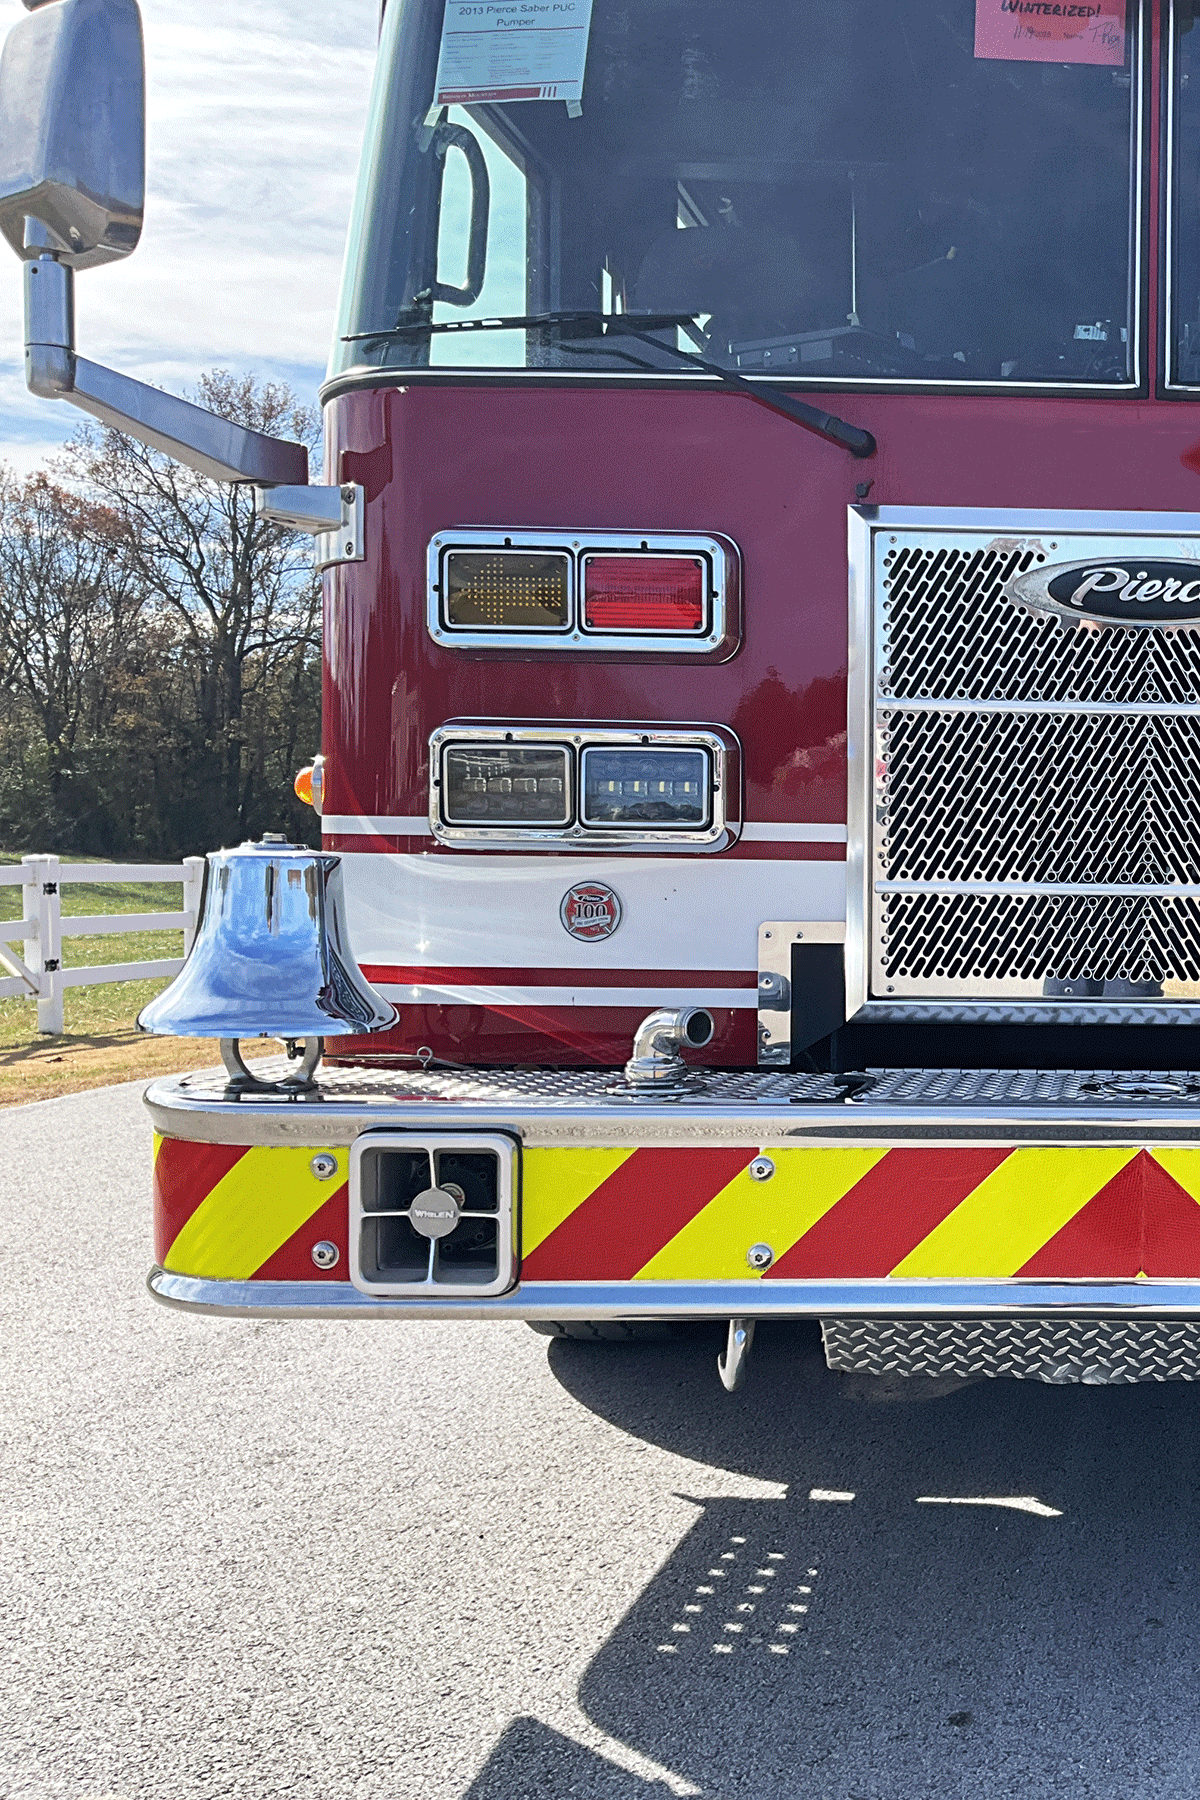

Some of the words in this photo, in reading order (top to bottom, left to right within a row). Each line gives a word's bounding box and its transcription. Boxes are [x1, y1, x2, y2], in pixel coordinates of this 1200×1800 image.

[459, 7, 484, 16] 2013
[486, 5, 518, 15] Pierce
[520, 4, 550, 13] Saber
[552, 3, 576, 12] PUC
[496, 18, 536, 27] Pumper
[574, 903, 608, 918] 100
[414, 1209, 455, 1219] WHELEN
